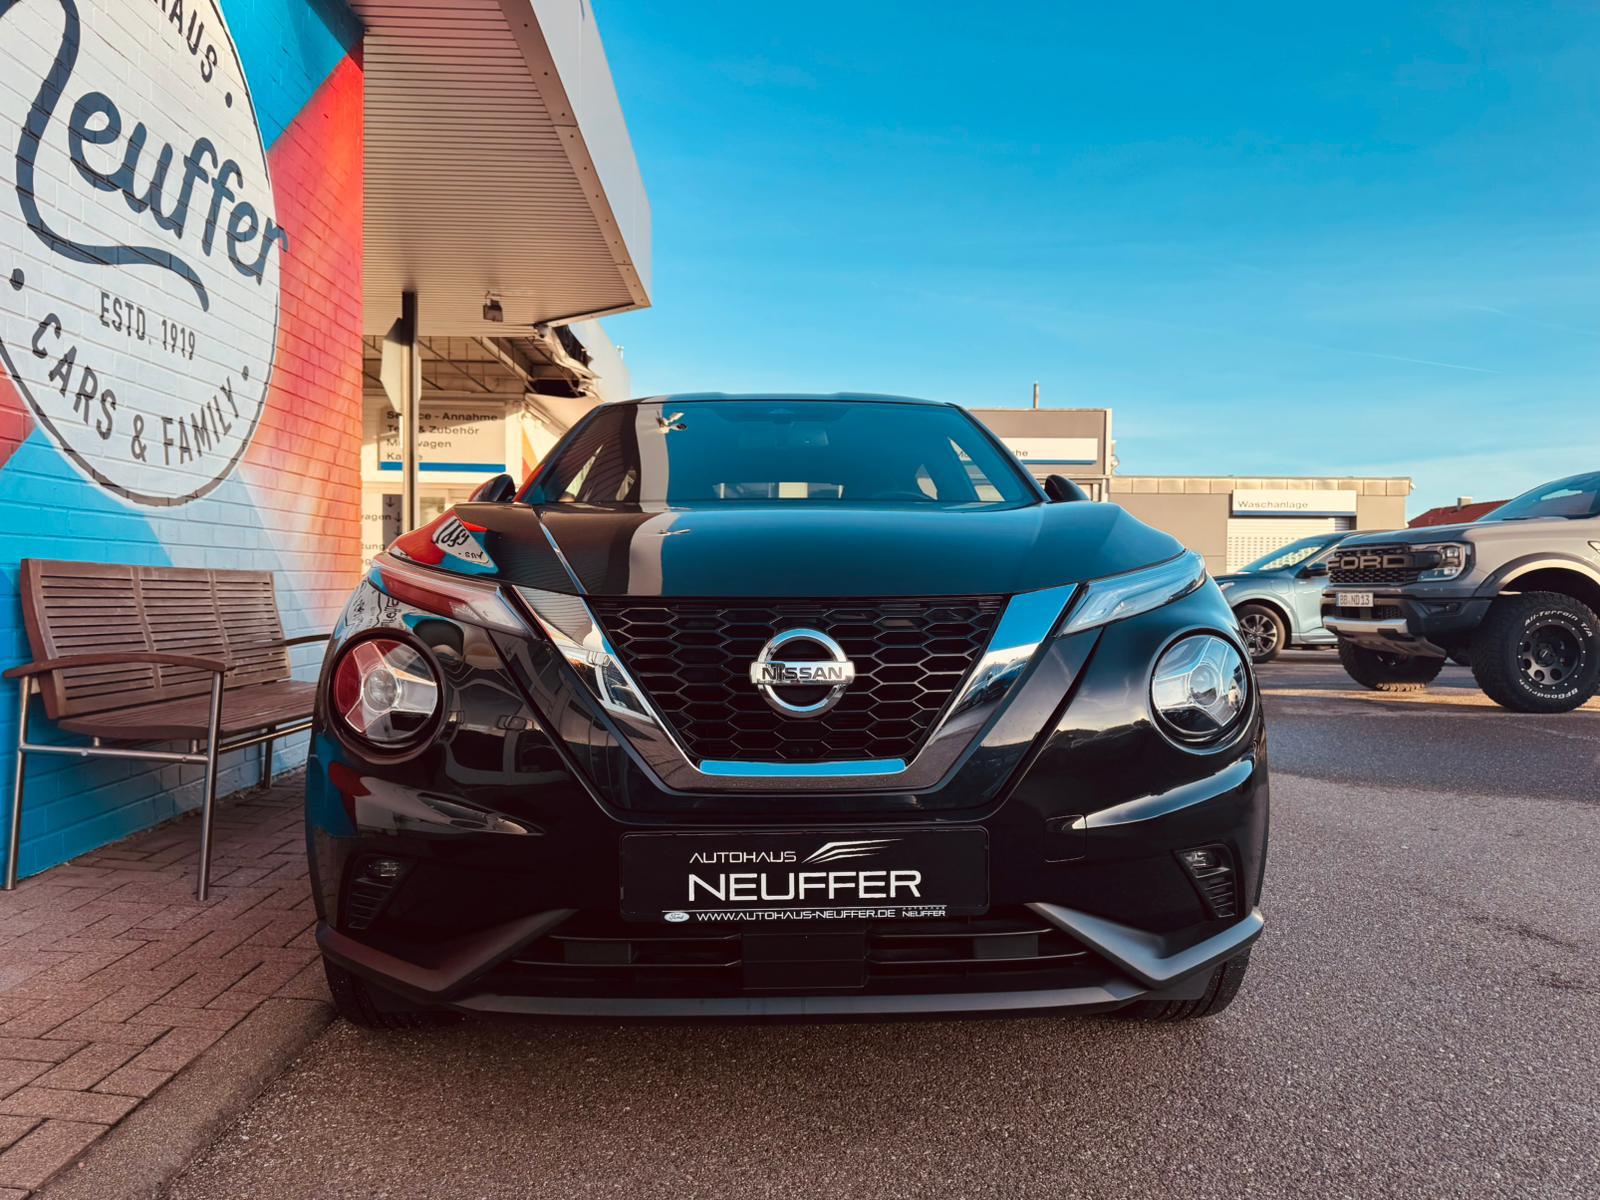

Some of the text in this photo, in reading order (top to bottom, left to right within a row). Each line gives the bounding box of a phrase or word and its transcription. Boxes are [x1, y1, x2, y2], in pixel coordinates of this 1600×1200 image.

[161, 319, 196, 360] 1919
[31, 313, 239, 465] CARS & FAMILY
[442, 412, 498, 421] Annahme
[429, 425, 480, 434] Zubehör
[1237, 500, 1309, 509] Waschanlage
[1327, 555, 1409, 572] FORD
[762, 667, 843, 680] NISSAN
[689, 851, 797, 864] AUTOHAUS
[688, 870, 922, 902] NEUFFER
[696, 909, 896, 921] WWW.AUTOHAUS-NEUFFER.DE
[902, 910, 946, 918] NEUFFER
